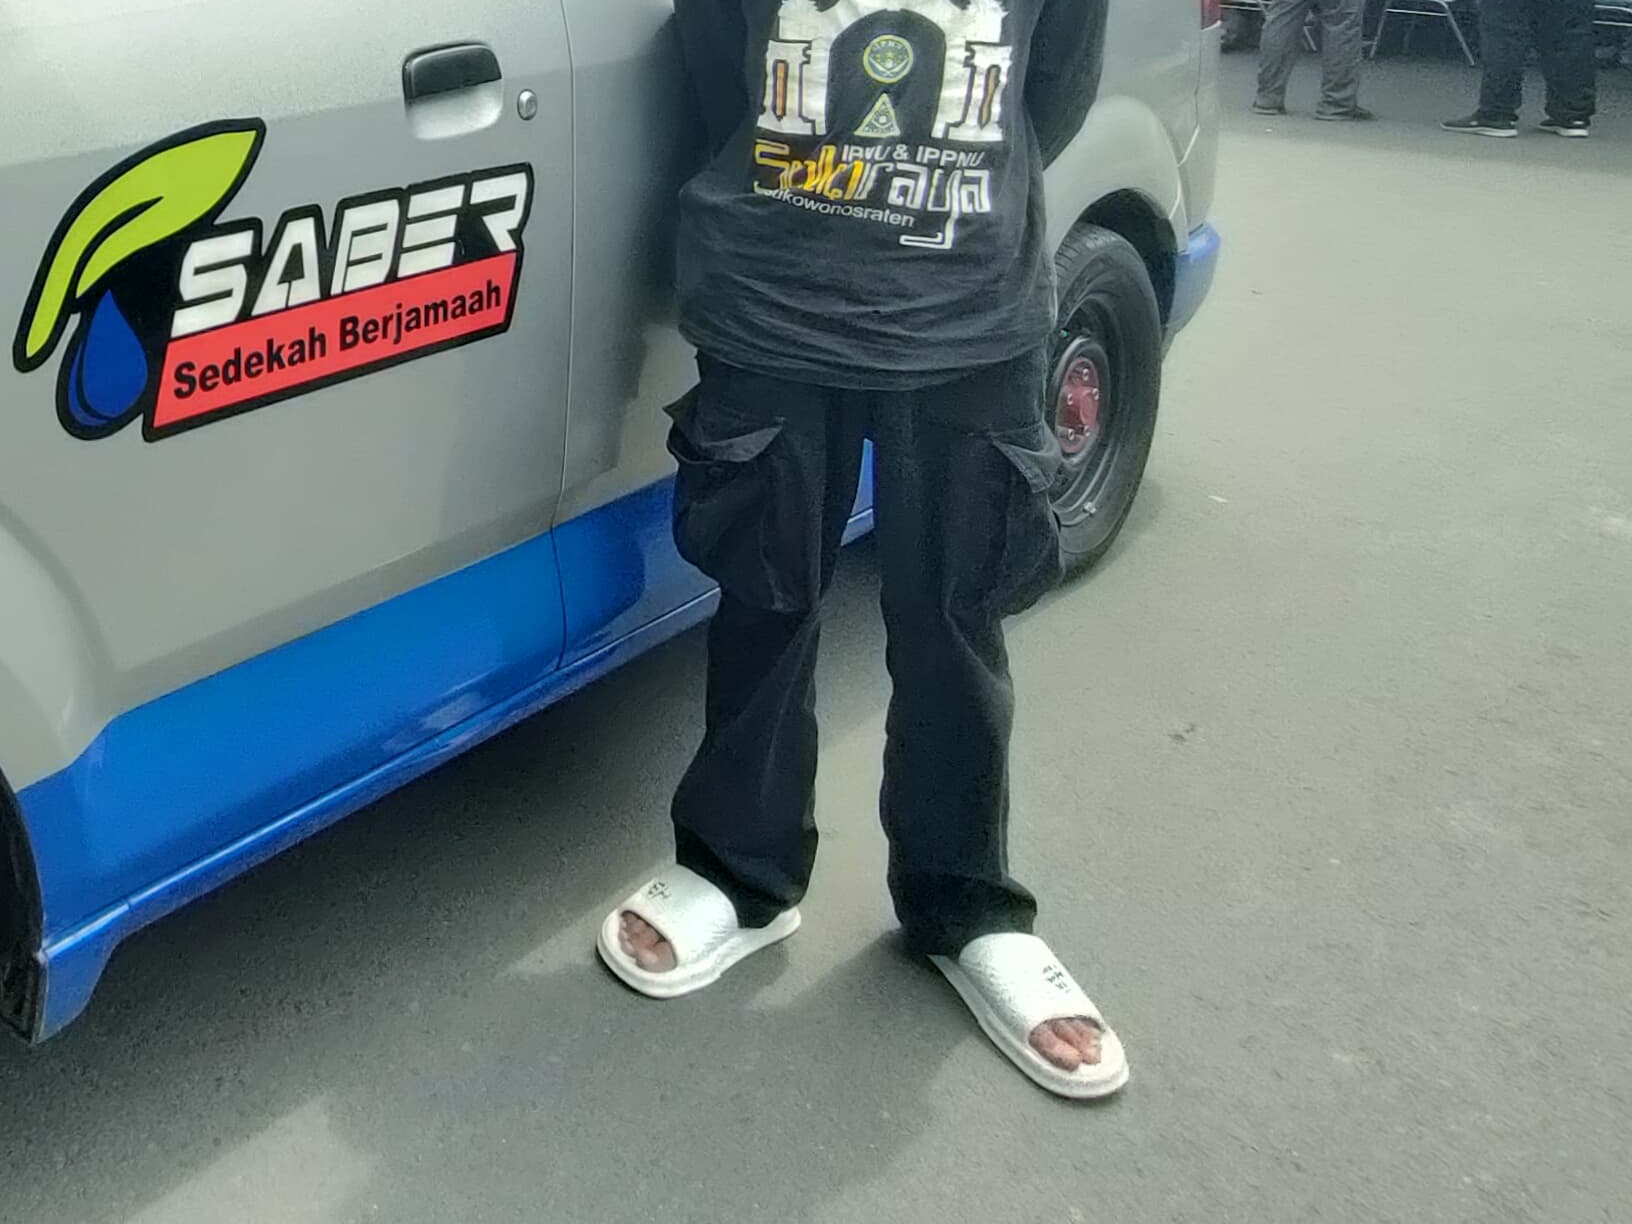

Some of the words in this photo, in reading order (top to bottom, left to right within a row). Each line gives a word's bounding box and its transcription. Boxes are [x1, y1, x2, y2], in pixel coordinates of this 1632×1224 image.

[892, 143, 909, 160] &
[915, 145, 985, 168] IPPNU
[170, 171, 529, 338] SABER
[173, 326, 327, 399] Sedekah
[339, 279, 502, 351] Berjamaah
